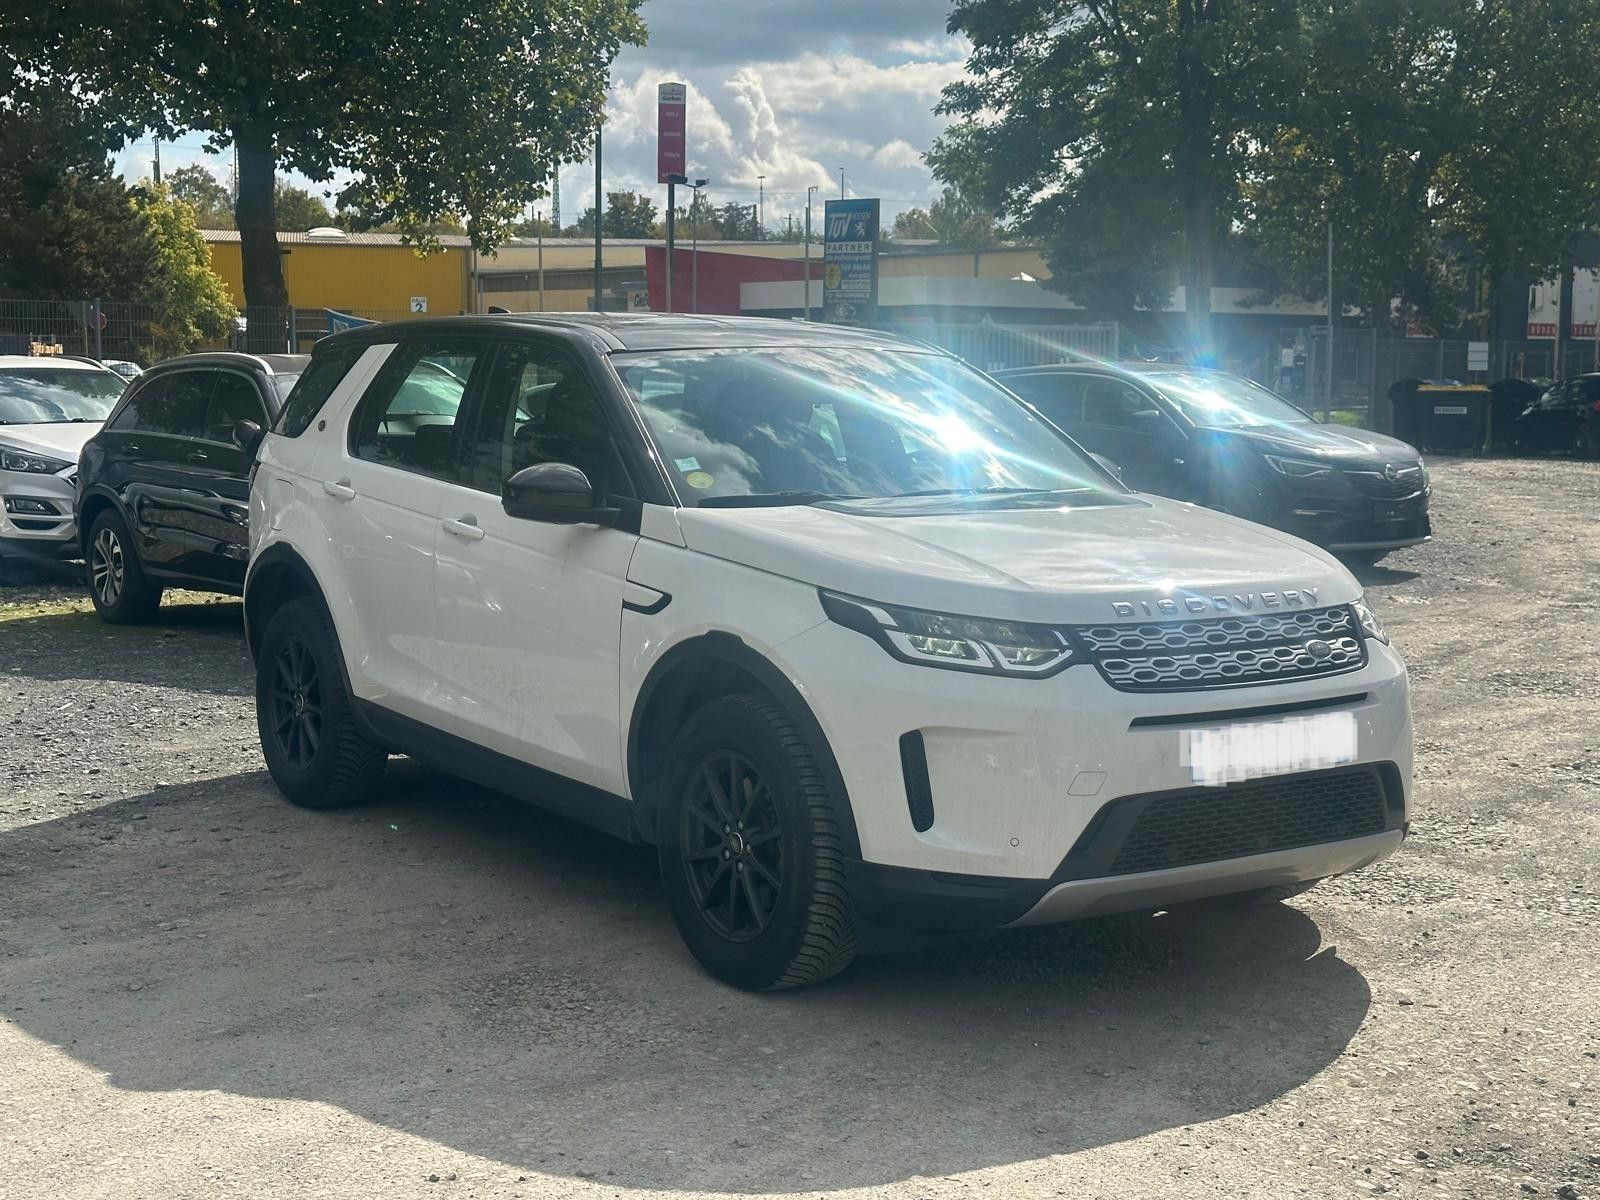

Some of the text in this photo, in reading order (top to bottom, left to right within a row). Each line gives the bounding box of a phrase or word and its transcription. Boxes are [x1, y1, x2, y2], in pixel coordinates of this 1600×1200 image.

[827, 243, 870, 252] PARTNER
[415, 303, 423, 312] 2
[1112, 587, 1319, 618] DISCOVERY
